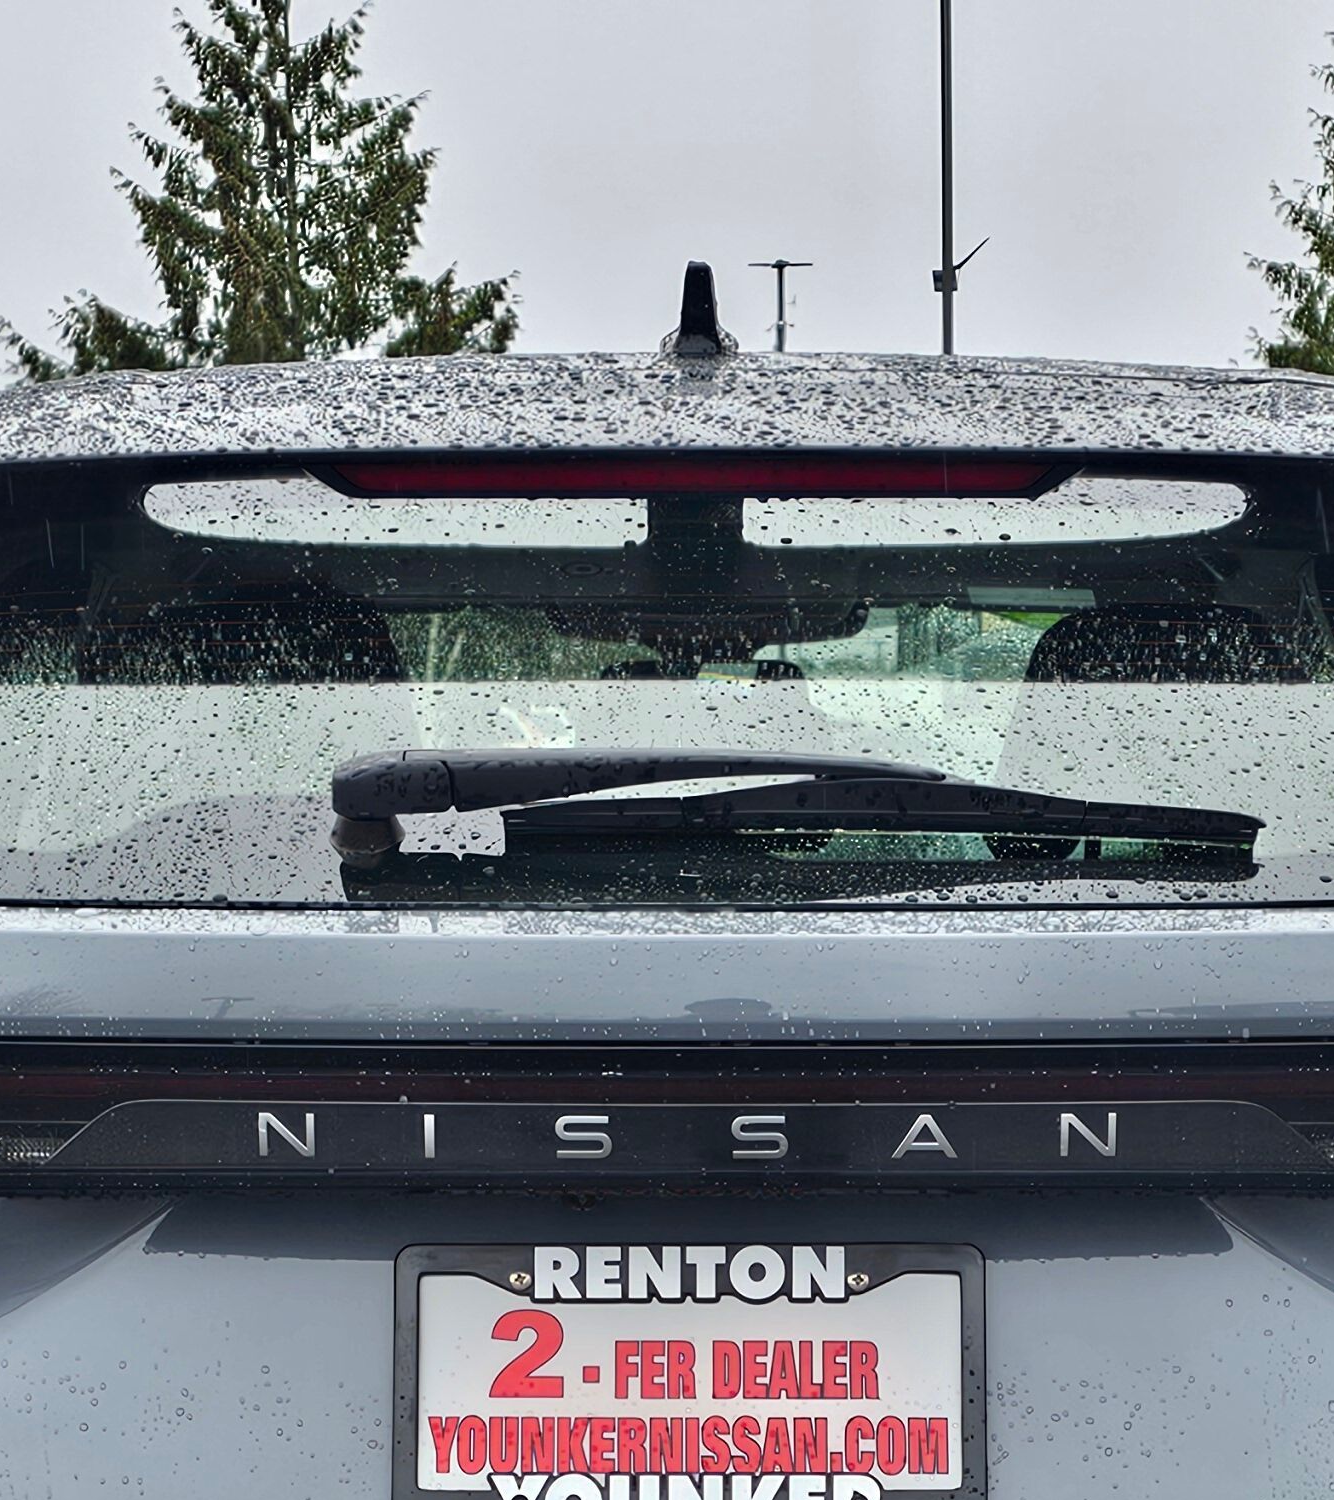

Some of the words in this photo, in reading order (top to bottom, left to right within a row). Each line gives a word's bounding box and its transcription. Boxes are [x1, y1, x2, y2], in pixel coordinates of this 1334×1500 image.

[256, 1111, 1118, 1159] NISSAN
[533, 1245, 847, 1300] RENTON
[711, 1340, 881, 1400] DEALER
[427, 1415, 950, 1476] YOUNKERNISSAN.COM
